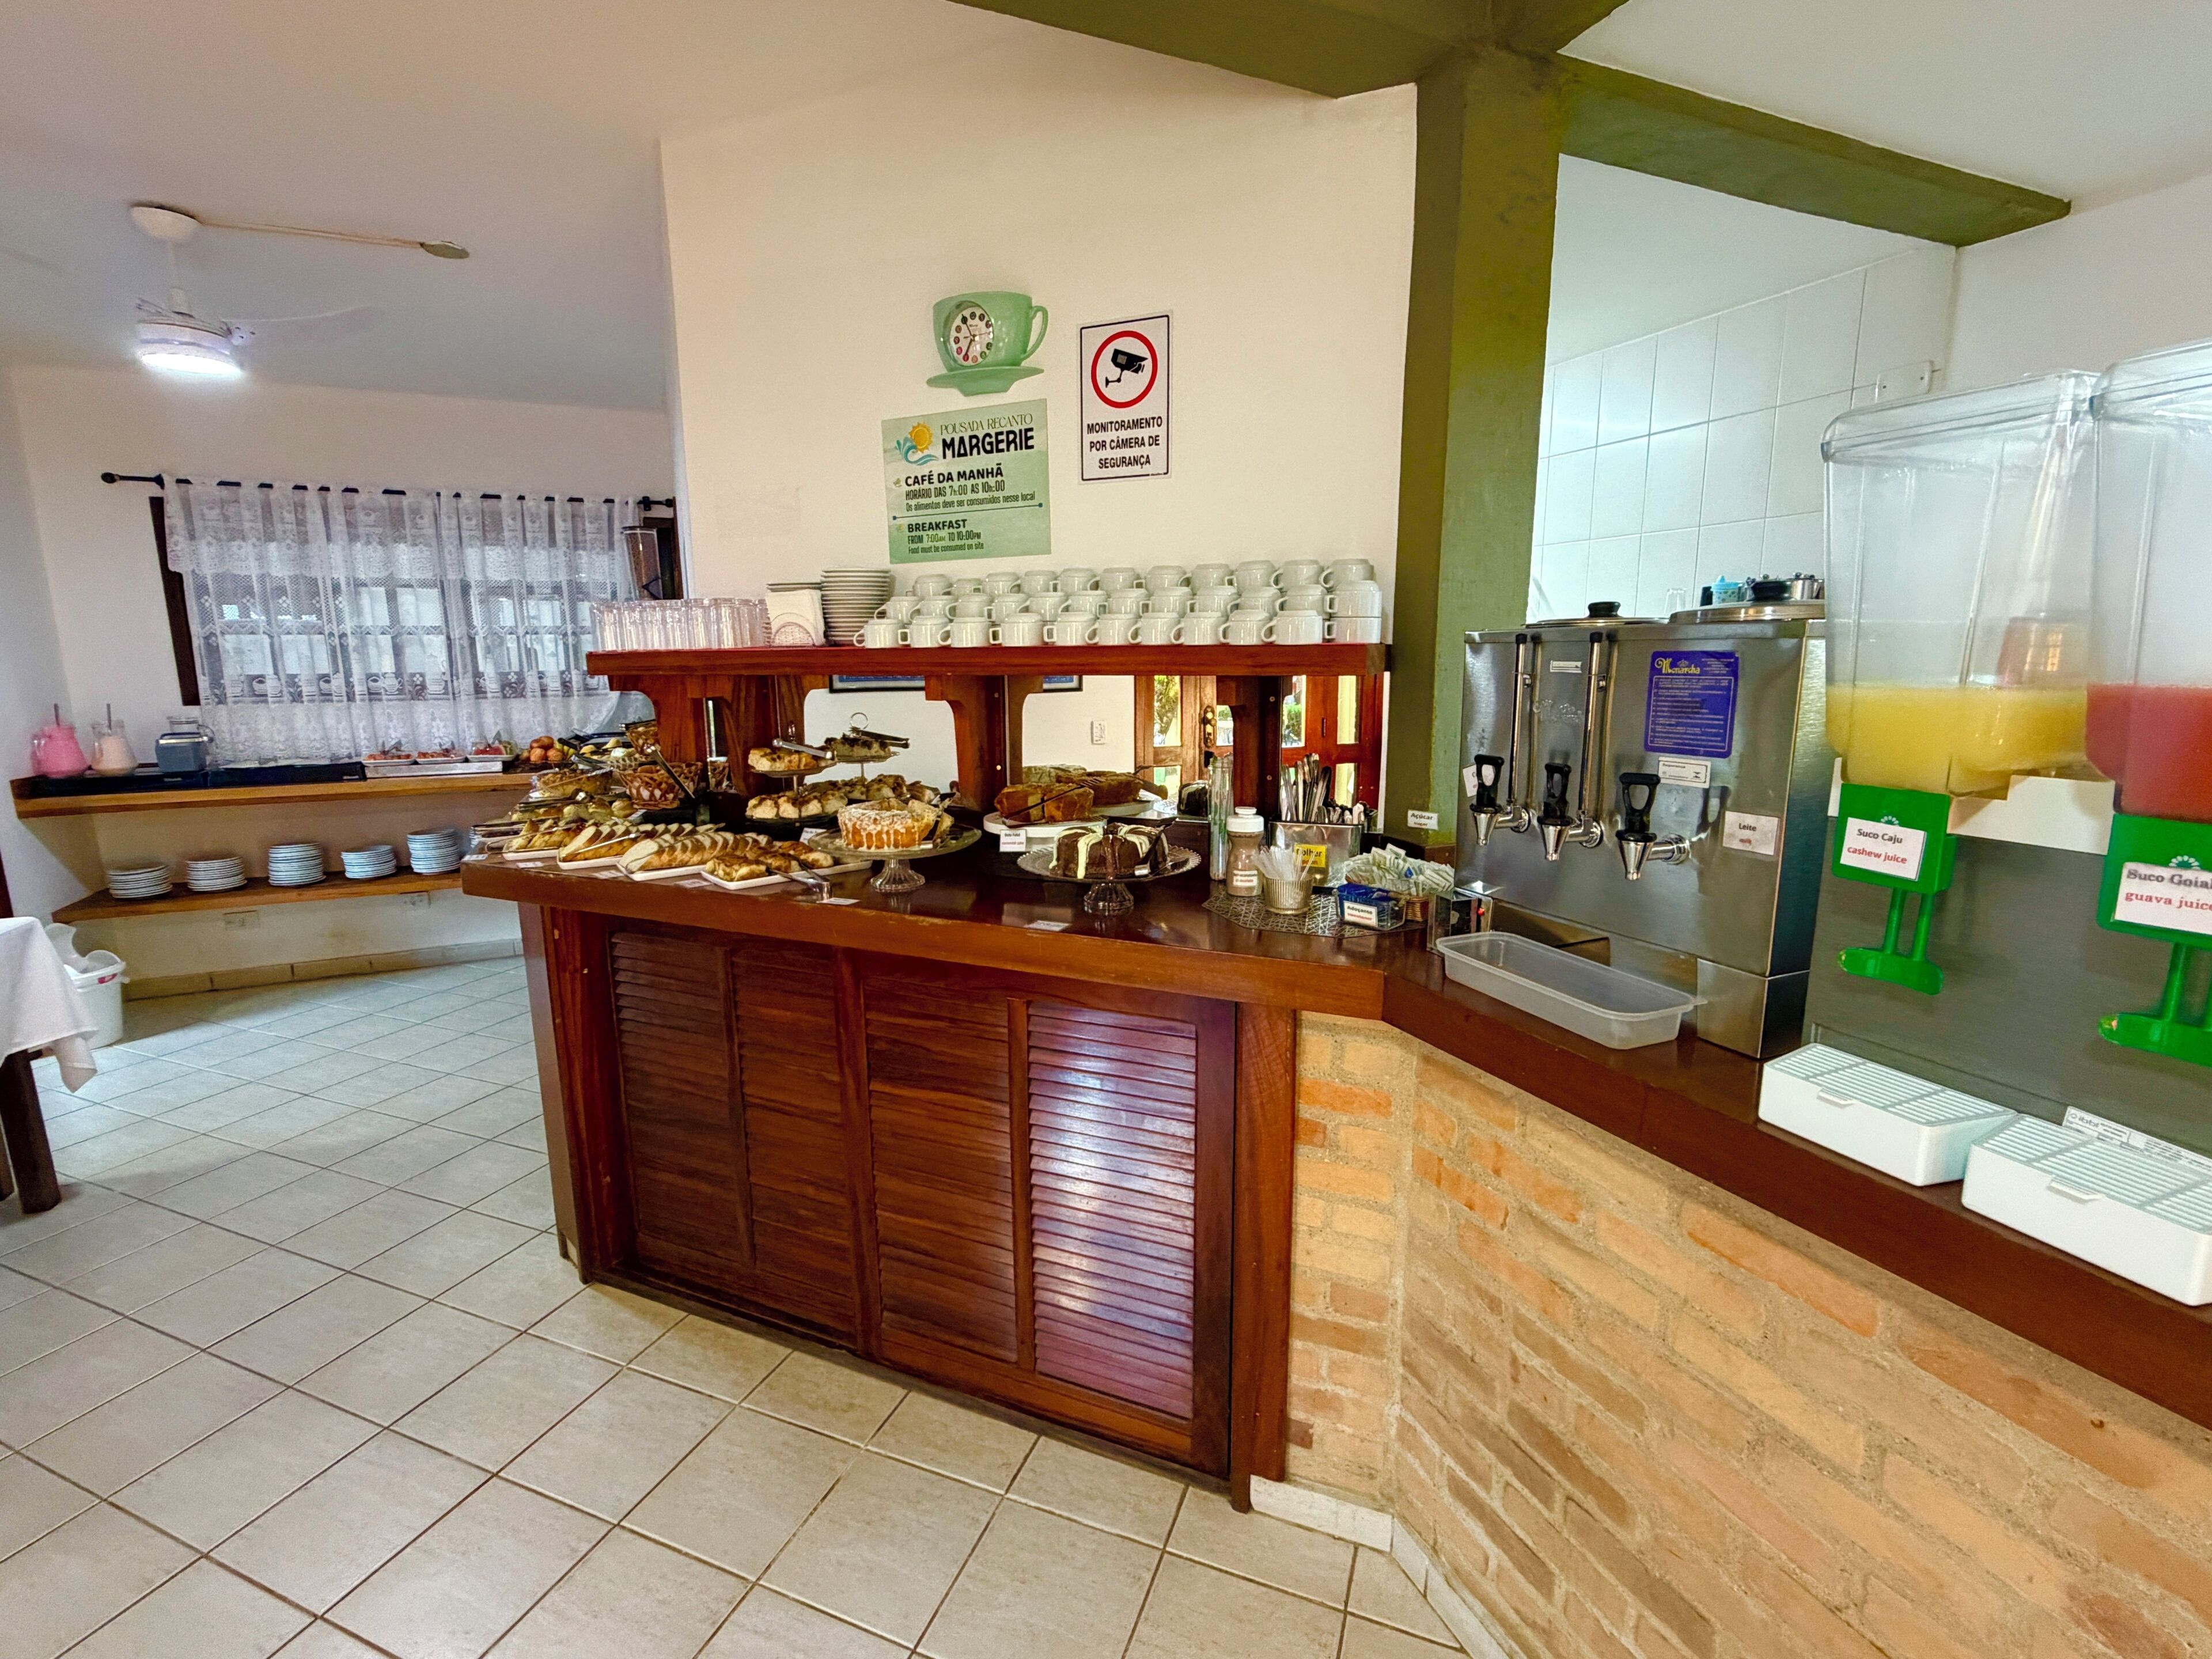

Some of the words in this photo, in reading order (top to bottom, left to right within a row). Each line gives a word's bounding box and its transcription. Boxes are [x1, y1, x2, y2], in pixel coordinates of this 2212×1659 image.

[940, 420, 984, 435] POUSADA
[987, 413, 1033, 430] RECANTO
[1087, 416, 1162, 434] MONITORAMENTO
[942, 427, 1035, 459] MARGERIE
[1090, 440, 1107, 452] POR
[1109, 435, 1146, 450] CÂMERA
[1148, 435, 1160, 447] DE
[1099, 454, 1151, 469] SEGURANÇA
[905, 470, 934, 487] CAFÉ
[937, 472, 954, 484] DA
[957, 463, 1003, 481] MANHÃ
[906, 487, 932, 501] HORÁRIO
[934, 486, 947, 498] DAS
[971, 483, 979, 494] AS
[906, 502, 912, 512] Os
[914, 501, 941, 511] alimentos
[942, 499, 955, 508] deve
[967, 494, 1001, 506] consumidos
[1002, 494, 1019, 503] nesse
[1021, 490, 1035, 501] local
[907, 519, 967, 532] BREAKFAST
[908, 535, 923, 544] FROM
[948, 532, 955, 541] TO
[957, 530, 981, 541] 10:00PM
[934, 544, 940, 552] be
[941, 543, 965, 552] consumed
[1738, 823, 1757, 832] Leite
[1857, 828, 1879, 839] Suco
[1881, 833, 1903, 844] Caju
[1847, 846, 1882, 858] cashew
[1883, 852, 1907, 863] juice
[2127, 869, 2165, 882] Suco
[2169, 874, 2212, 889] Goia
[2125, 892, 2172, 905] guava
